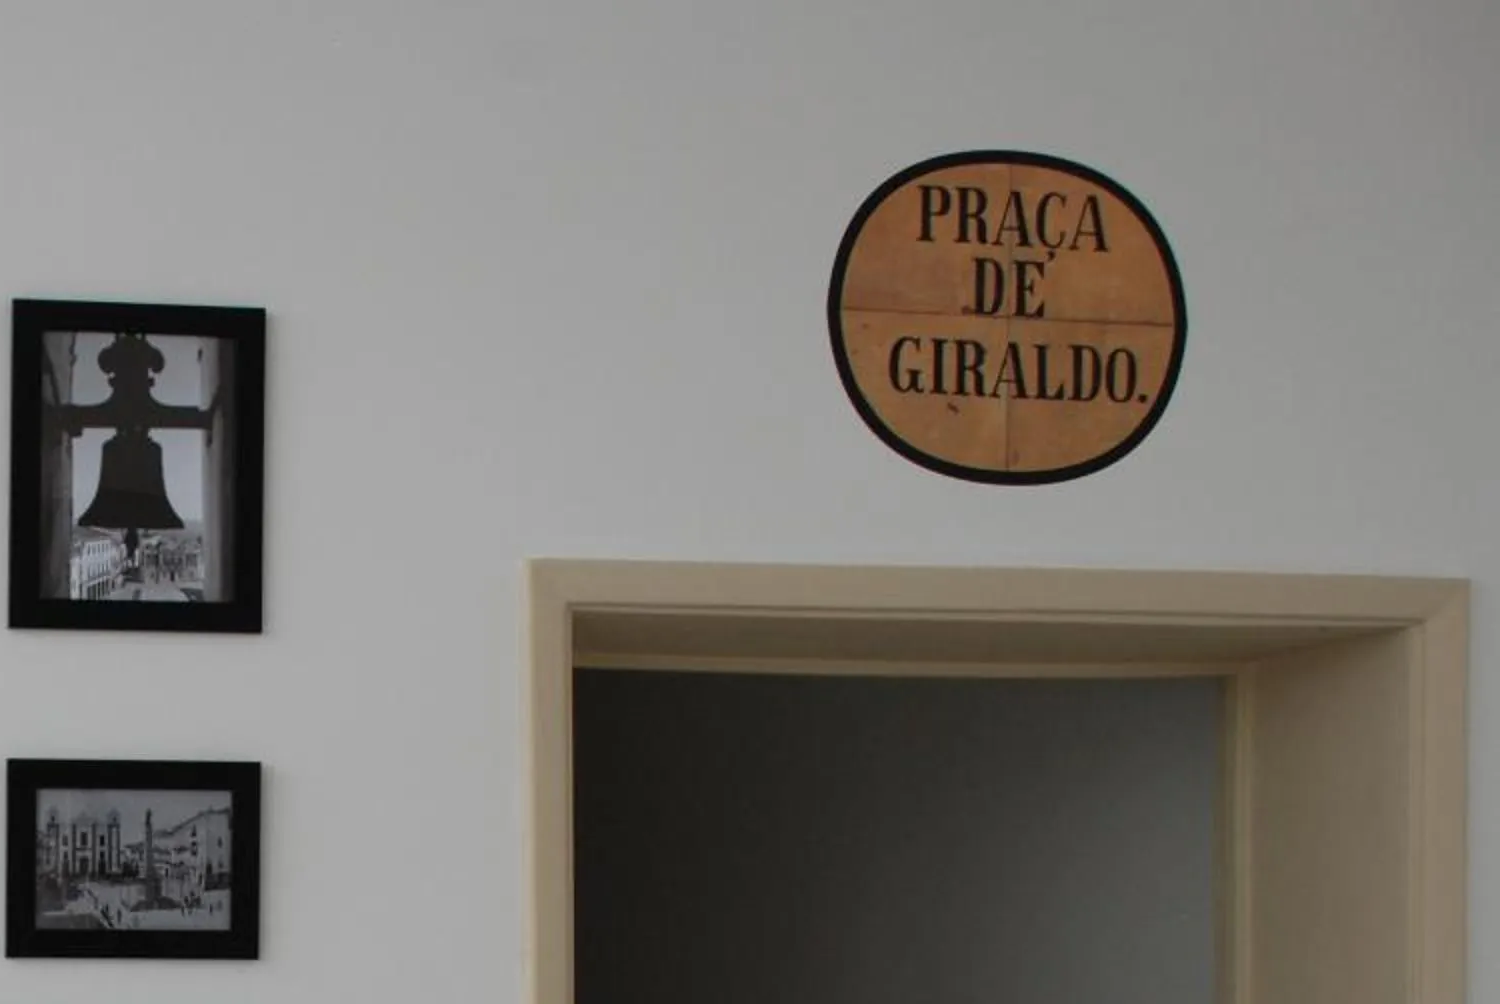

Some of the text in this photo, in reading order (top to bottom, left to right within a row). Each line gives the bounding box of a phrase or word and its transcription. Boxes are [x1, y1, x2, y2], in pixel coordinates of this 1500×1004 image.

[915, 184, 1110, 260] PRAÇA
[970, 256, 1047, 319] DE
[888, 335, 1149, 404] GIRALDO.
